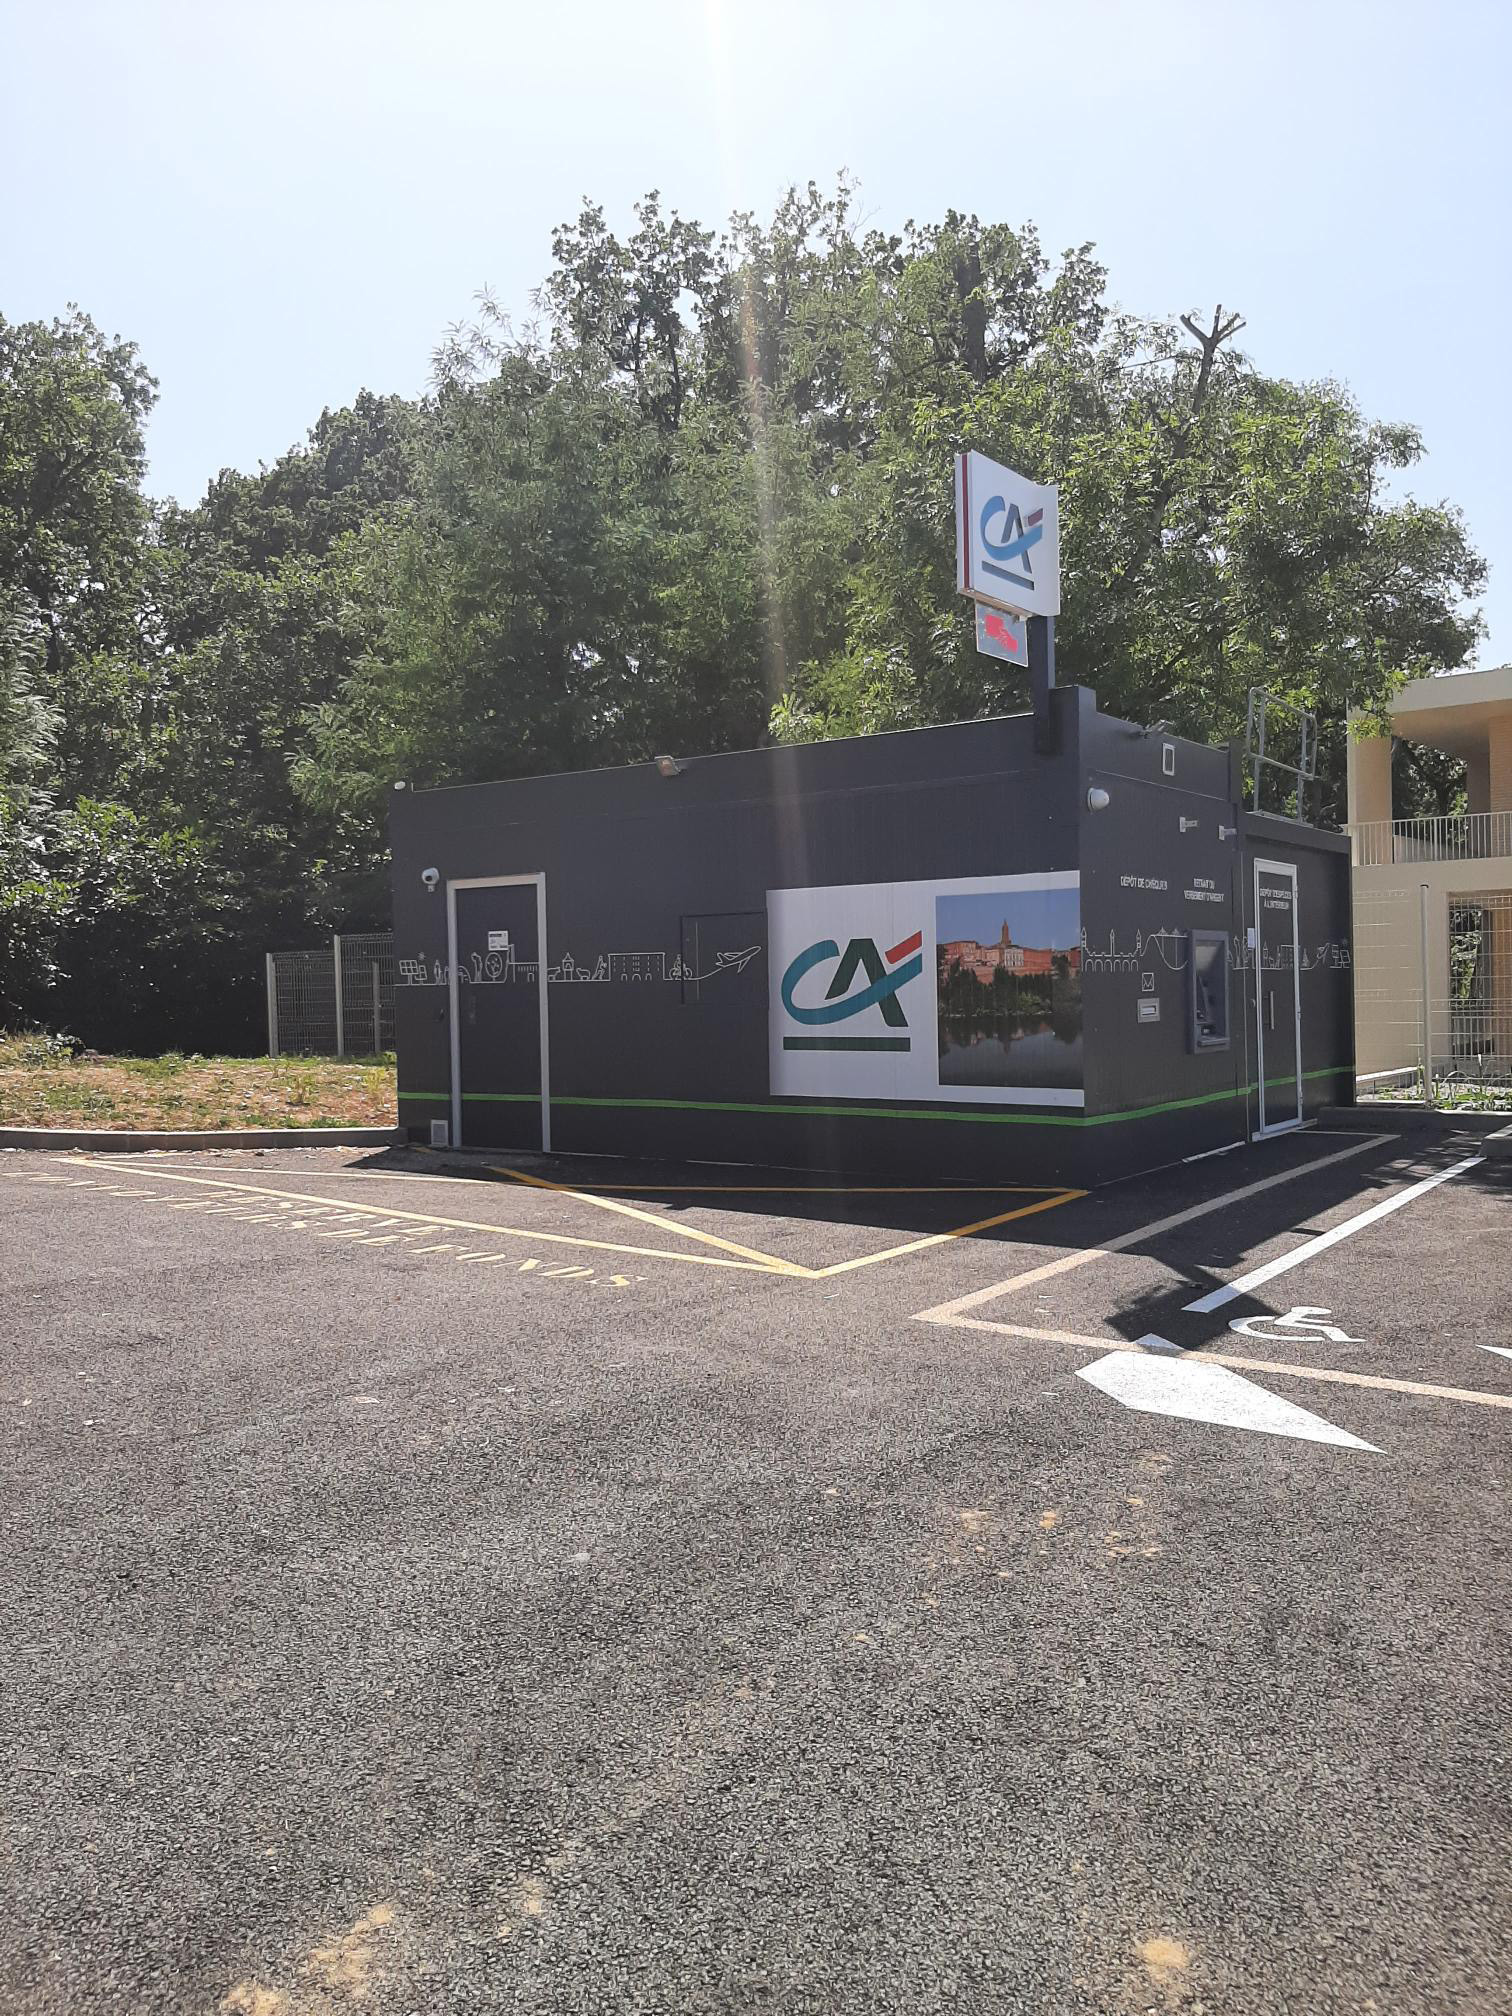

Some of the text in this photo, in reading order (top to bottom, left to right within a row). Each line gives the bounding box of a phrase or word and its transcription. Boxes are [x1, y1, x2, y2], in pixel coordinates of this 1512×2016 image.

[980, 495, 1043, 574] CA
[780, 929, 923, 1029] CA
[318, 1228, 417, 1247] DE
[405, 1243, 649, 1287] FONDS
